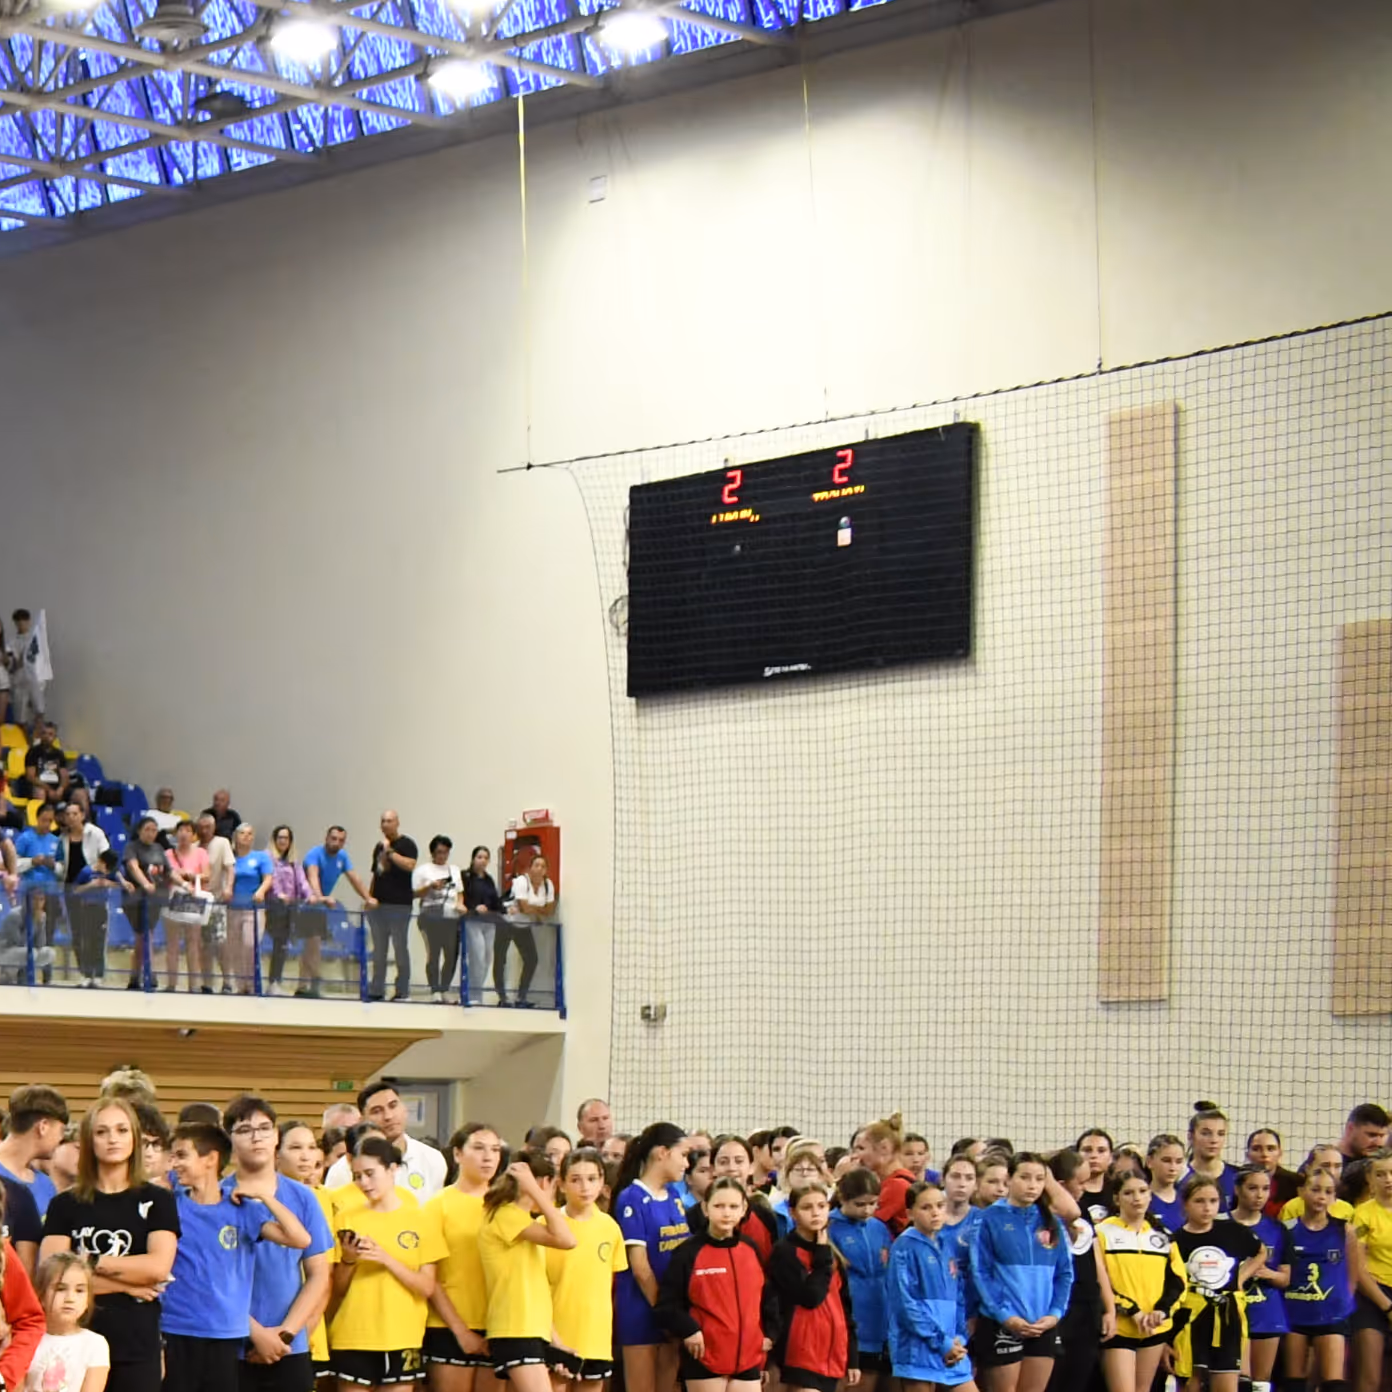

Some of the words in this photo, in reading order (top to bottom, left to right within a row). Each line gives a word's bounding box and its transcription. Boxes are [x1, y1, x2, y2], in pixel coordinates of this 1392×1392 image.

[723, 469, 741, 504] 2
[833, 448, 853, 484] 2
[1308, 1263, 1319, 1281] 3
